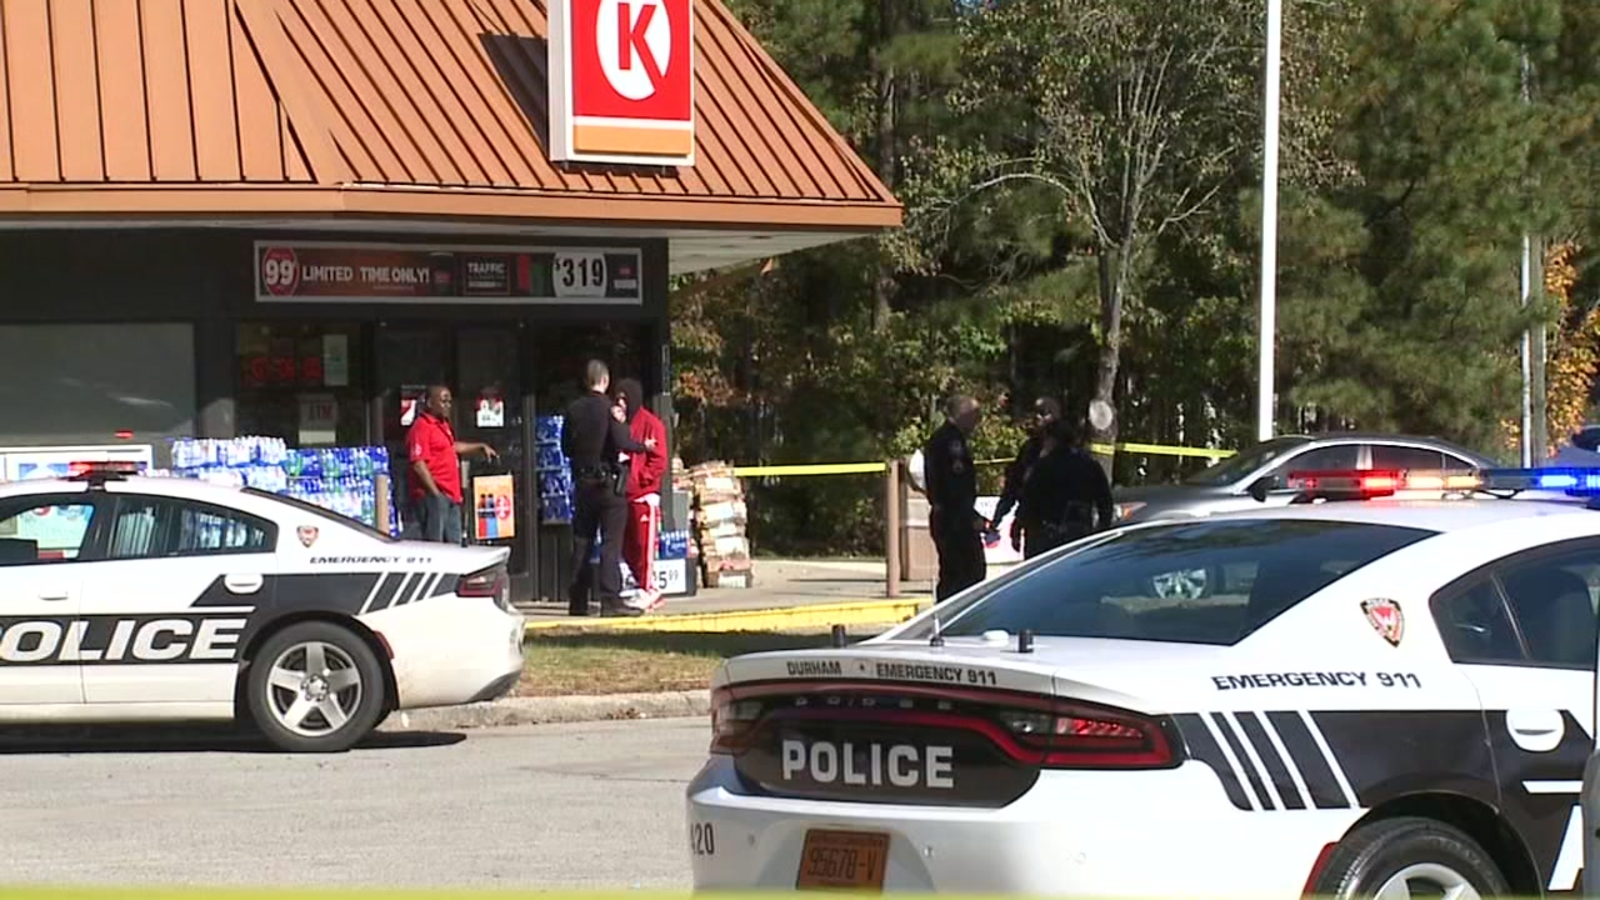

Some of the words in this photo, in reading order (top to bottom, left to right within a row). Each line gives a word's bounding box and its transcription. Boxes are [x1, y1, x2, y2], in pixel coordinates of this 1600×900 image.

[618, 2, 666, 91] K
[301, 266, 354, 282] LIMITED
[359, 266, 390, 283] TIME
[391, 267, 430, 284] ONLY!
[467, 262, 506, 273] TRAFFIC
[309, 555, 402, 565] EMERGENCY
[0, 618, 248, 662] OLICE
[786, 661, 842, 676] DURHAM
[876, 663, 963, 682] EMERGENCY
[967, 669, 997, 685] 911
[1211, 672, 1367, 690] EMERGENCY
[1375, 672, 1423, 689] 911
[782, 739, 954, 788] POLICE
[807, 848, 878, 881] 95678-V
